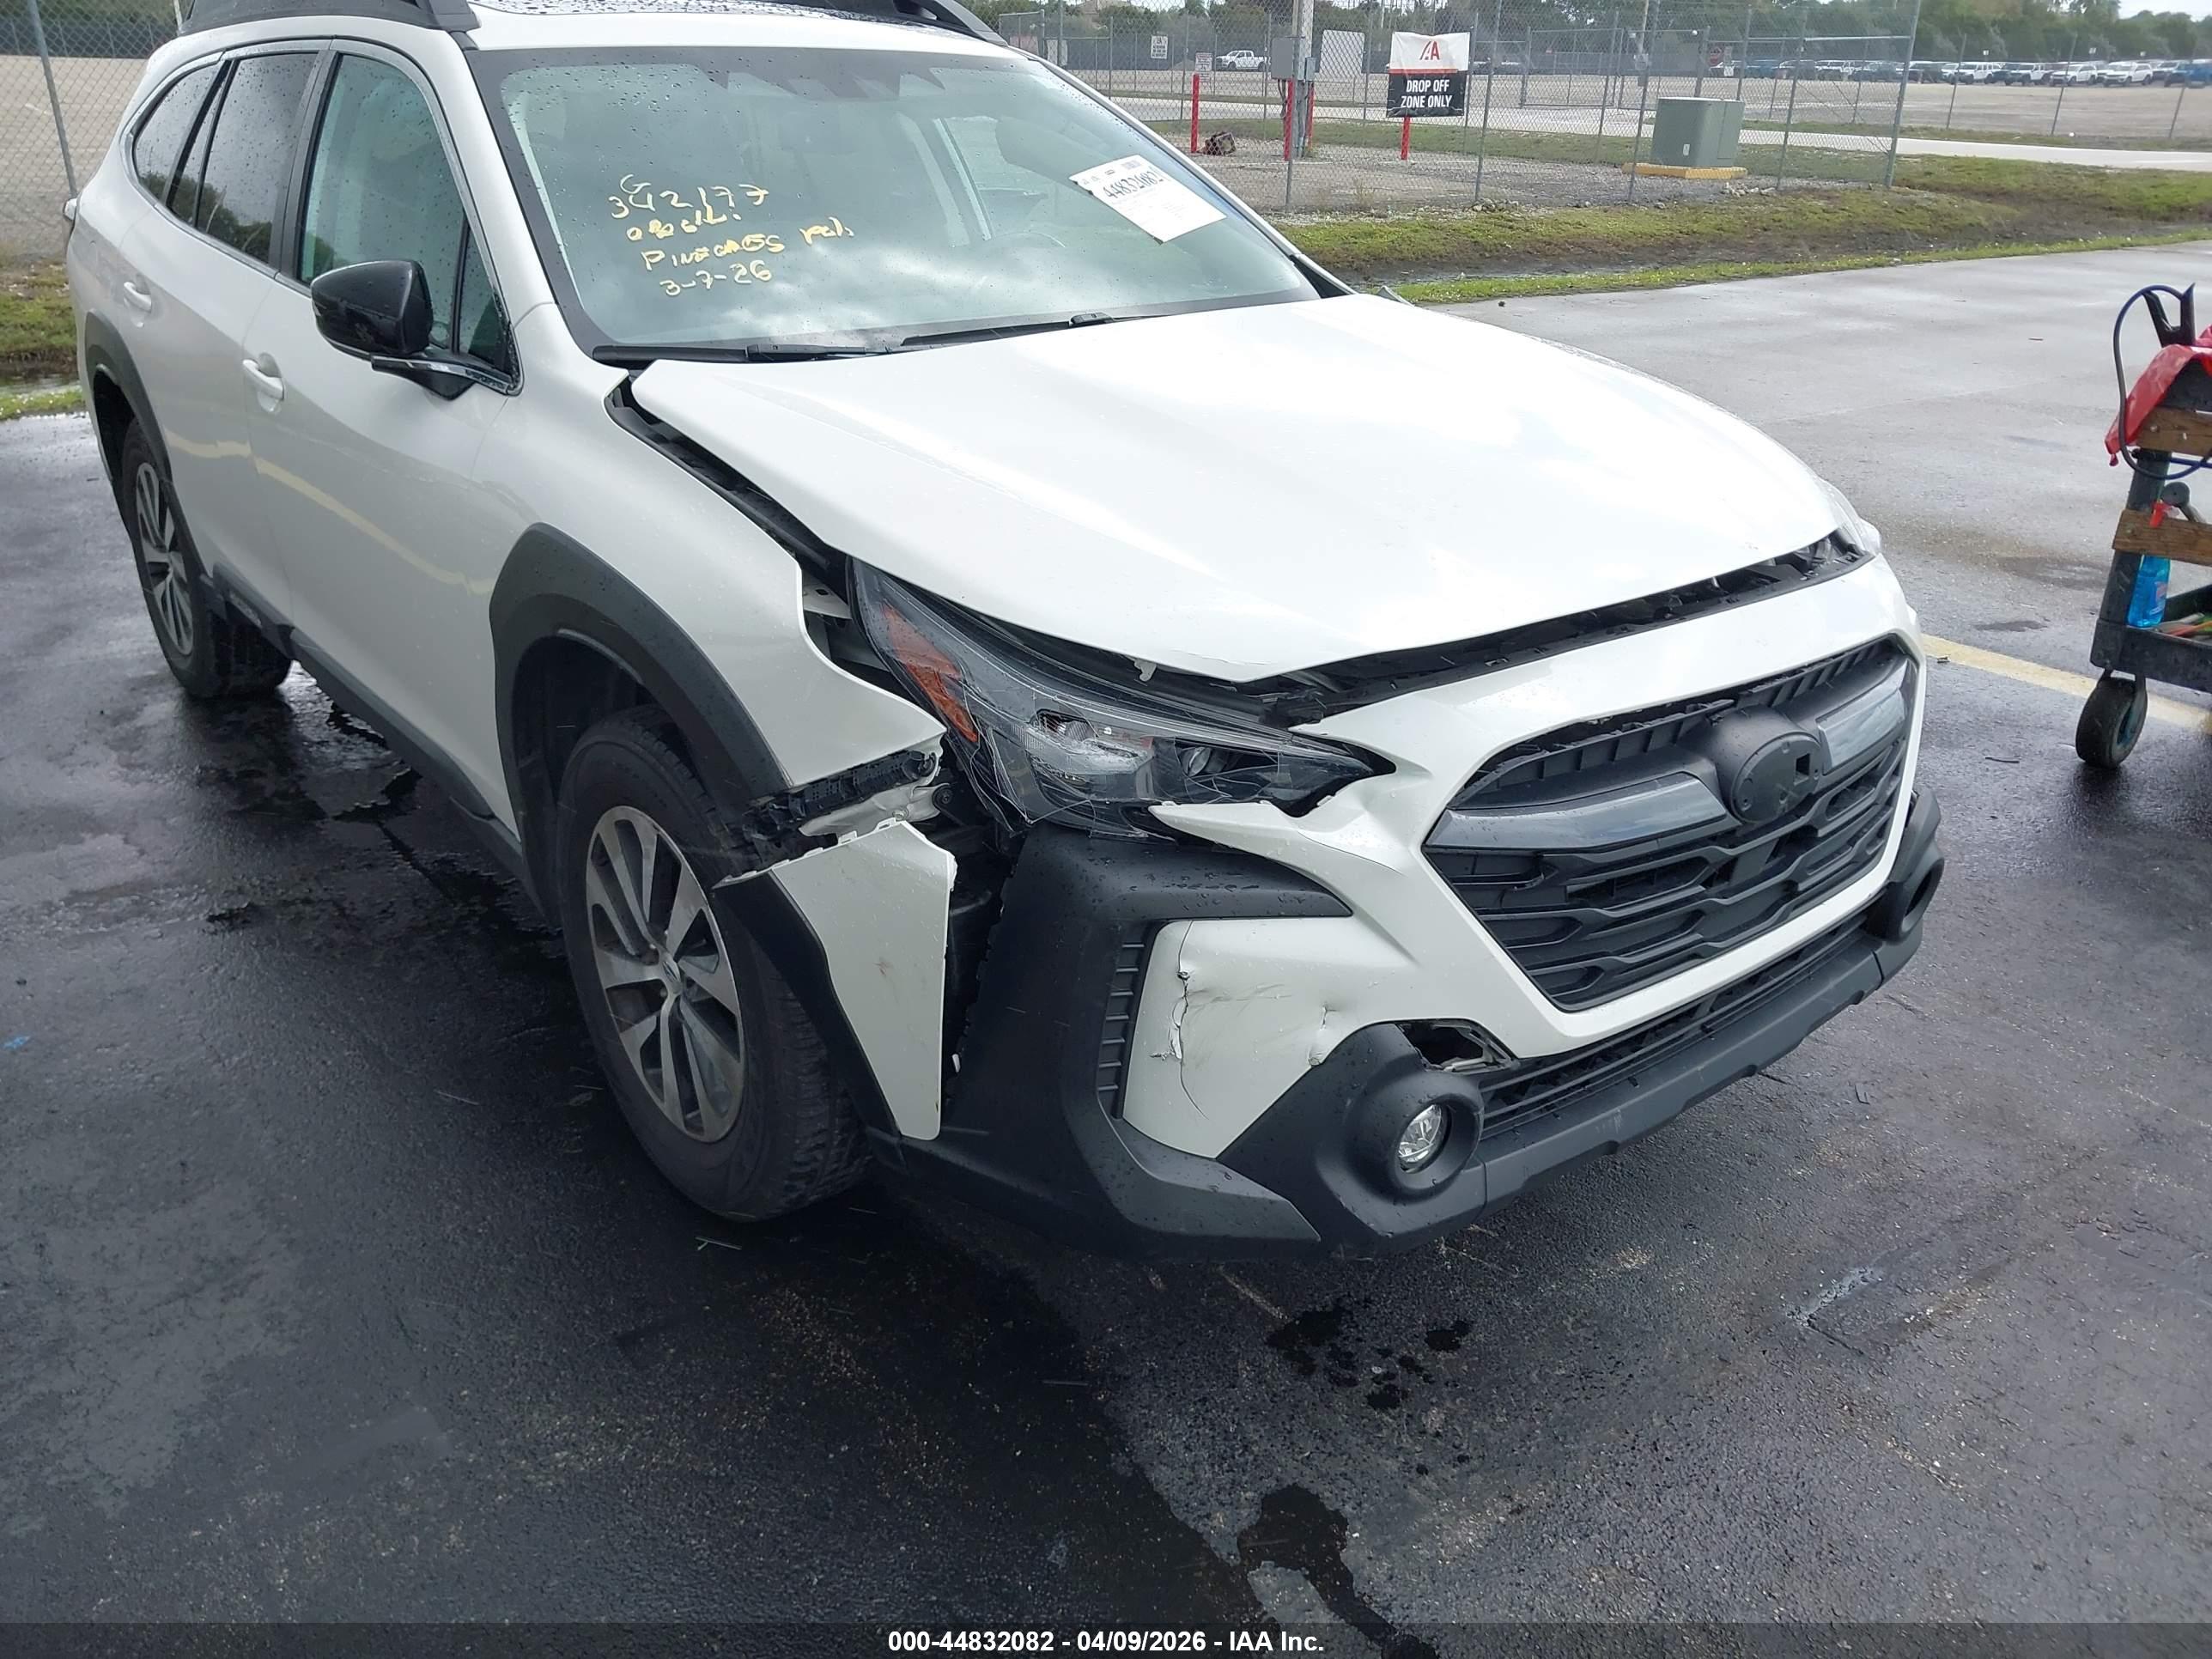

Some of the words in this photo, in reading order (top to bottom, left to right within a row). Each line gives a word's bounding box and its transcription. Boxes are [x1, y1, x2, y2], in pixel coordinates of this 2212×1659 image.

[1406, 79, 1431, 93] DROP
[1432, 79, 1449, 92] OFF
[1401, 94, 1425, 108] ZONE
[1427, 94, 1453, 107] ONLY
